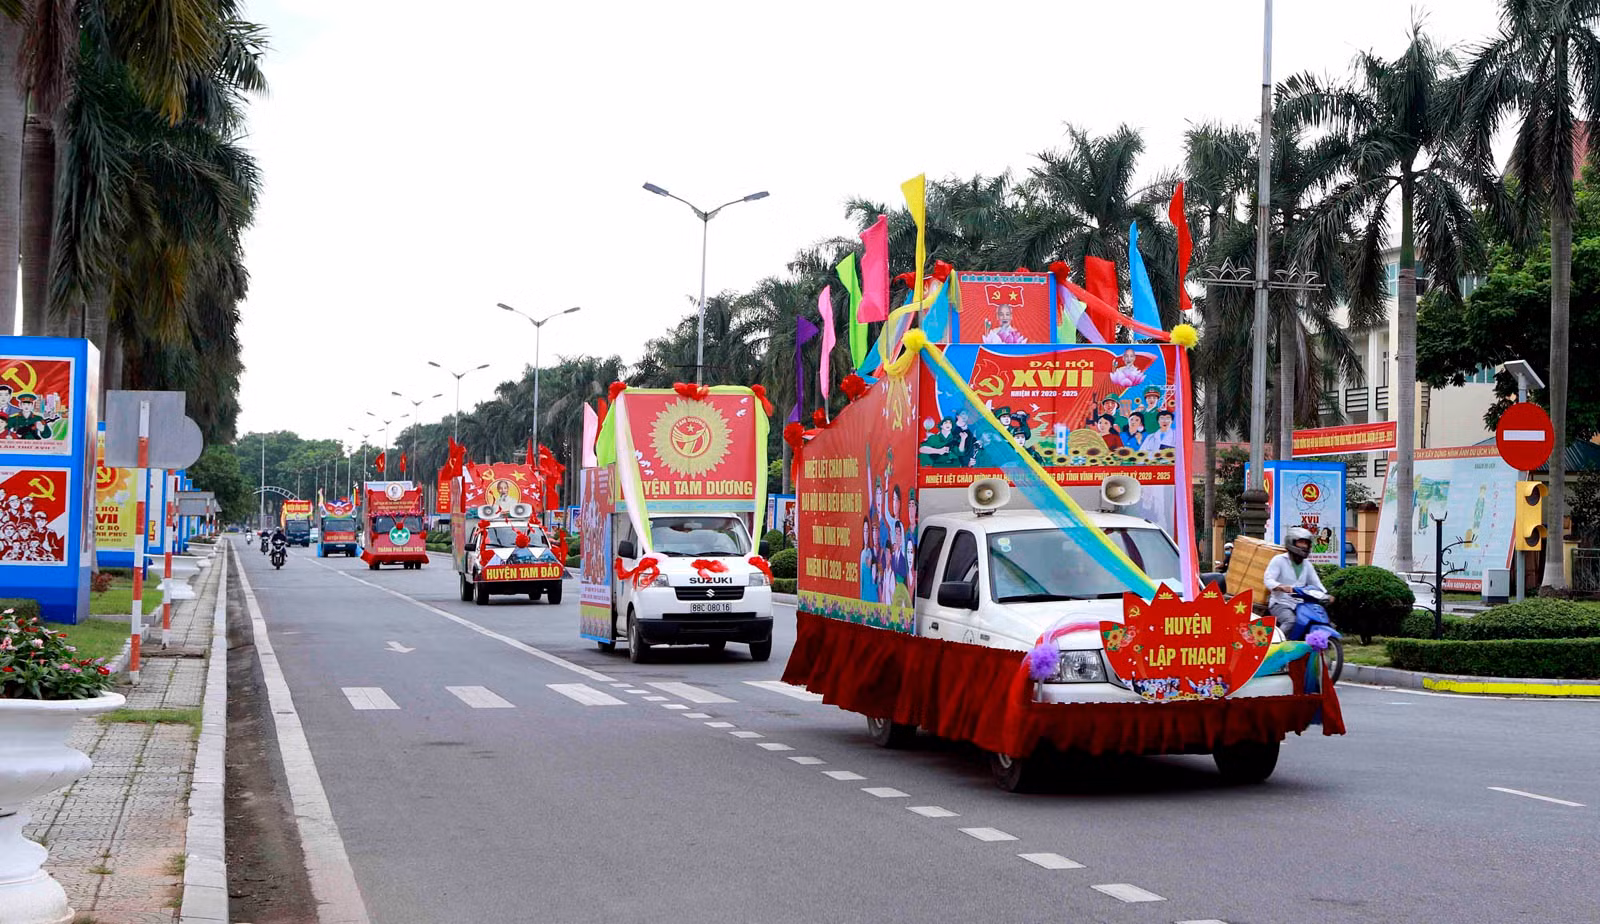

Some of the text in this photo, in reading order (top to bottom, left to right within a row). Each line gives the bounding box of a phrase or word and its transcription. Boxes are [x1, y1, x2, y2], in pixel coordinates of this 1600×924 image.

[1029, 359, 1094, 370] ĐẠI HỘI
[1011, 370, 1094, 388] XVII
[1010, 390, 1030, 398] NHIỆM
[926, 473, 942, 485] NHIỆT
[944, 472, 956, 485] LIỆT
[957, 472, 972, 483] CHÀO
[1056, 471, 1065, 483] BỘ
[1066, 470, 1078, 480] TỈNH
[1080, 471, 1093, 480] VĨNH
[1138, 472, 1152, 480] 2020
[1157, 472, 1170, 480] 2025
[642, 478, 753, 498] YỆN TAM DƯƠNG
[96, 514, 118, 524] VII
[1302, 516, 1319, 524] XVII
[486, 564, 560, 580] HUYỆN TAM ĐẢO
[692, 604, 706, 612] 88C
[1164, 612, 1212, 638] HUYỆN
[1150, 645, 1226, 670] LẬP THẠCH
